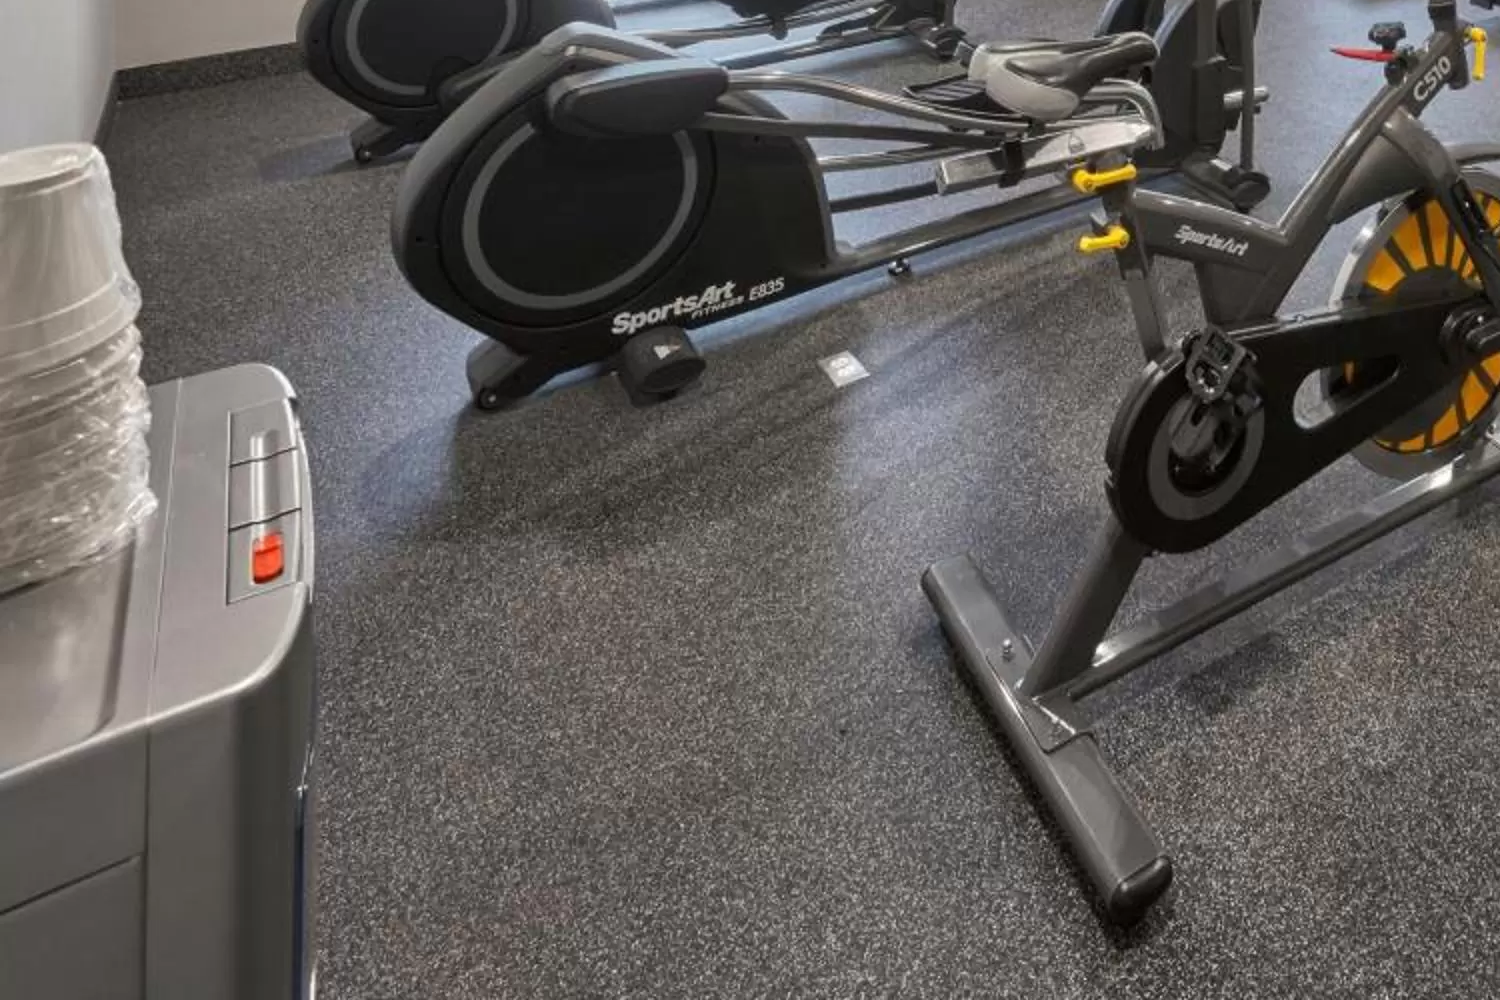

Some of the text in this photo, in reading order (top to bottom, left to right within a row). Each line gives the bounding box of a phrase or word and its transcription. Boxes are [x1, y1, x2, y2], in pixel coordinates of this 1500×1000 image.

[1413, 55, 1452, 102] C510
[1174, 224, 1249, 257] SportsArt
[611, 279, 736, 335] SportsArt
[749, 276, 786, 301] E835
